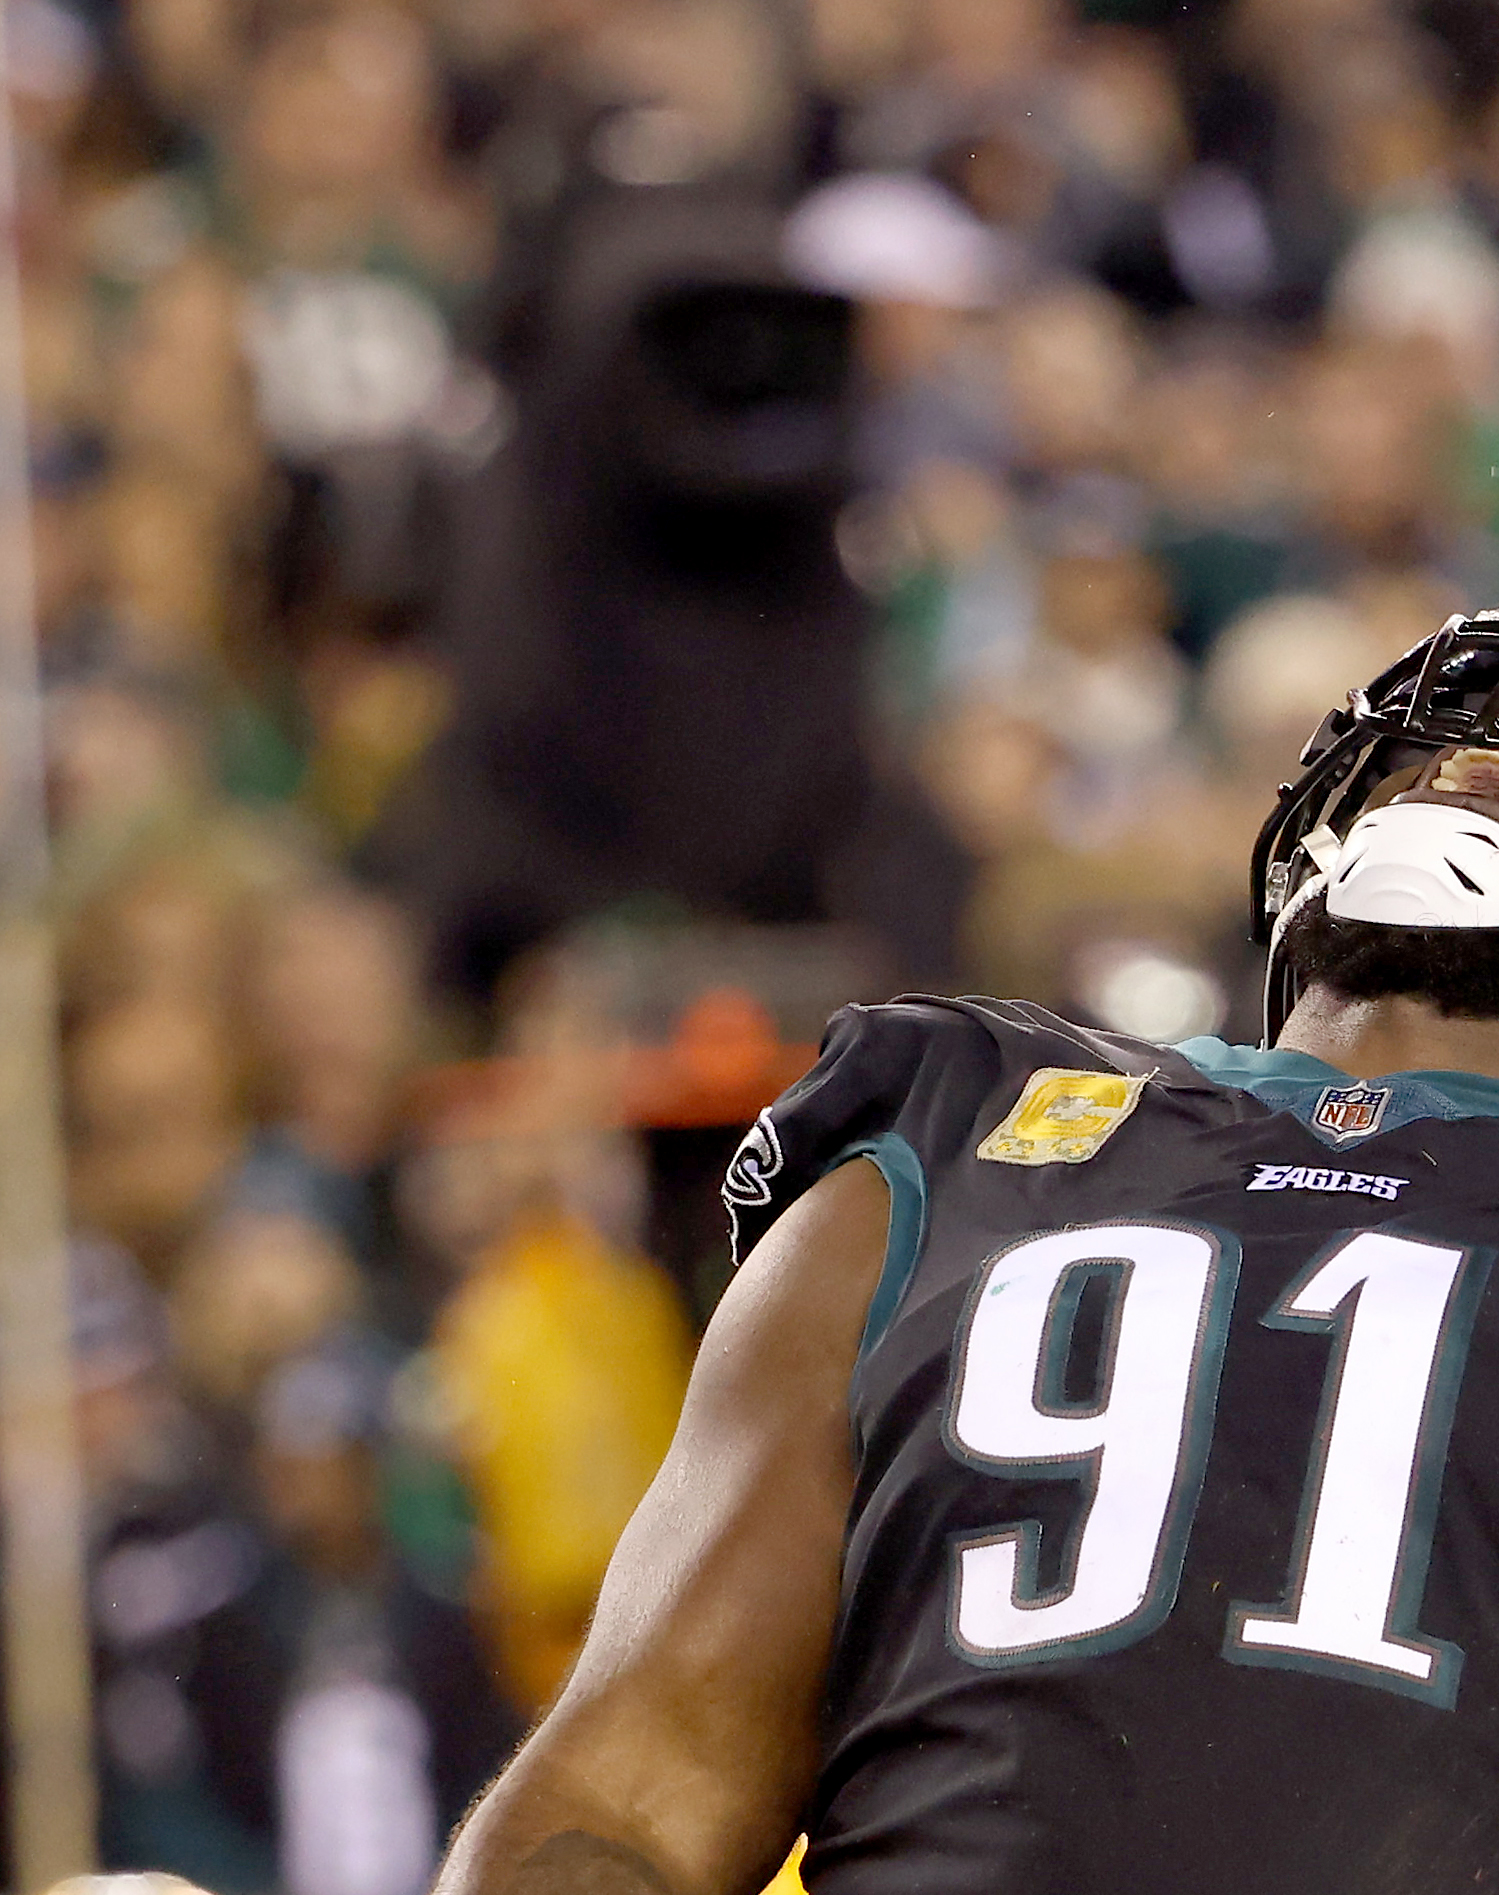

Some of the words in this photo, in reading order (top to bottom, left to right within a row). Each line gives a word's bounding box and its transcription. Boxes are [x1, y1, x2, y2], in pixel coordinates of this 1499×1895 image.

[1013, 1076, 1128, 1140] C
[1320, 1102, 1378, 1130] NFL
[1245, 1163, 1412, 1201] EAGLES
[947, 1218, 1478, 1692] 91
